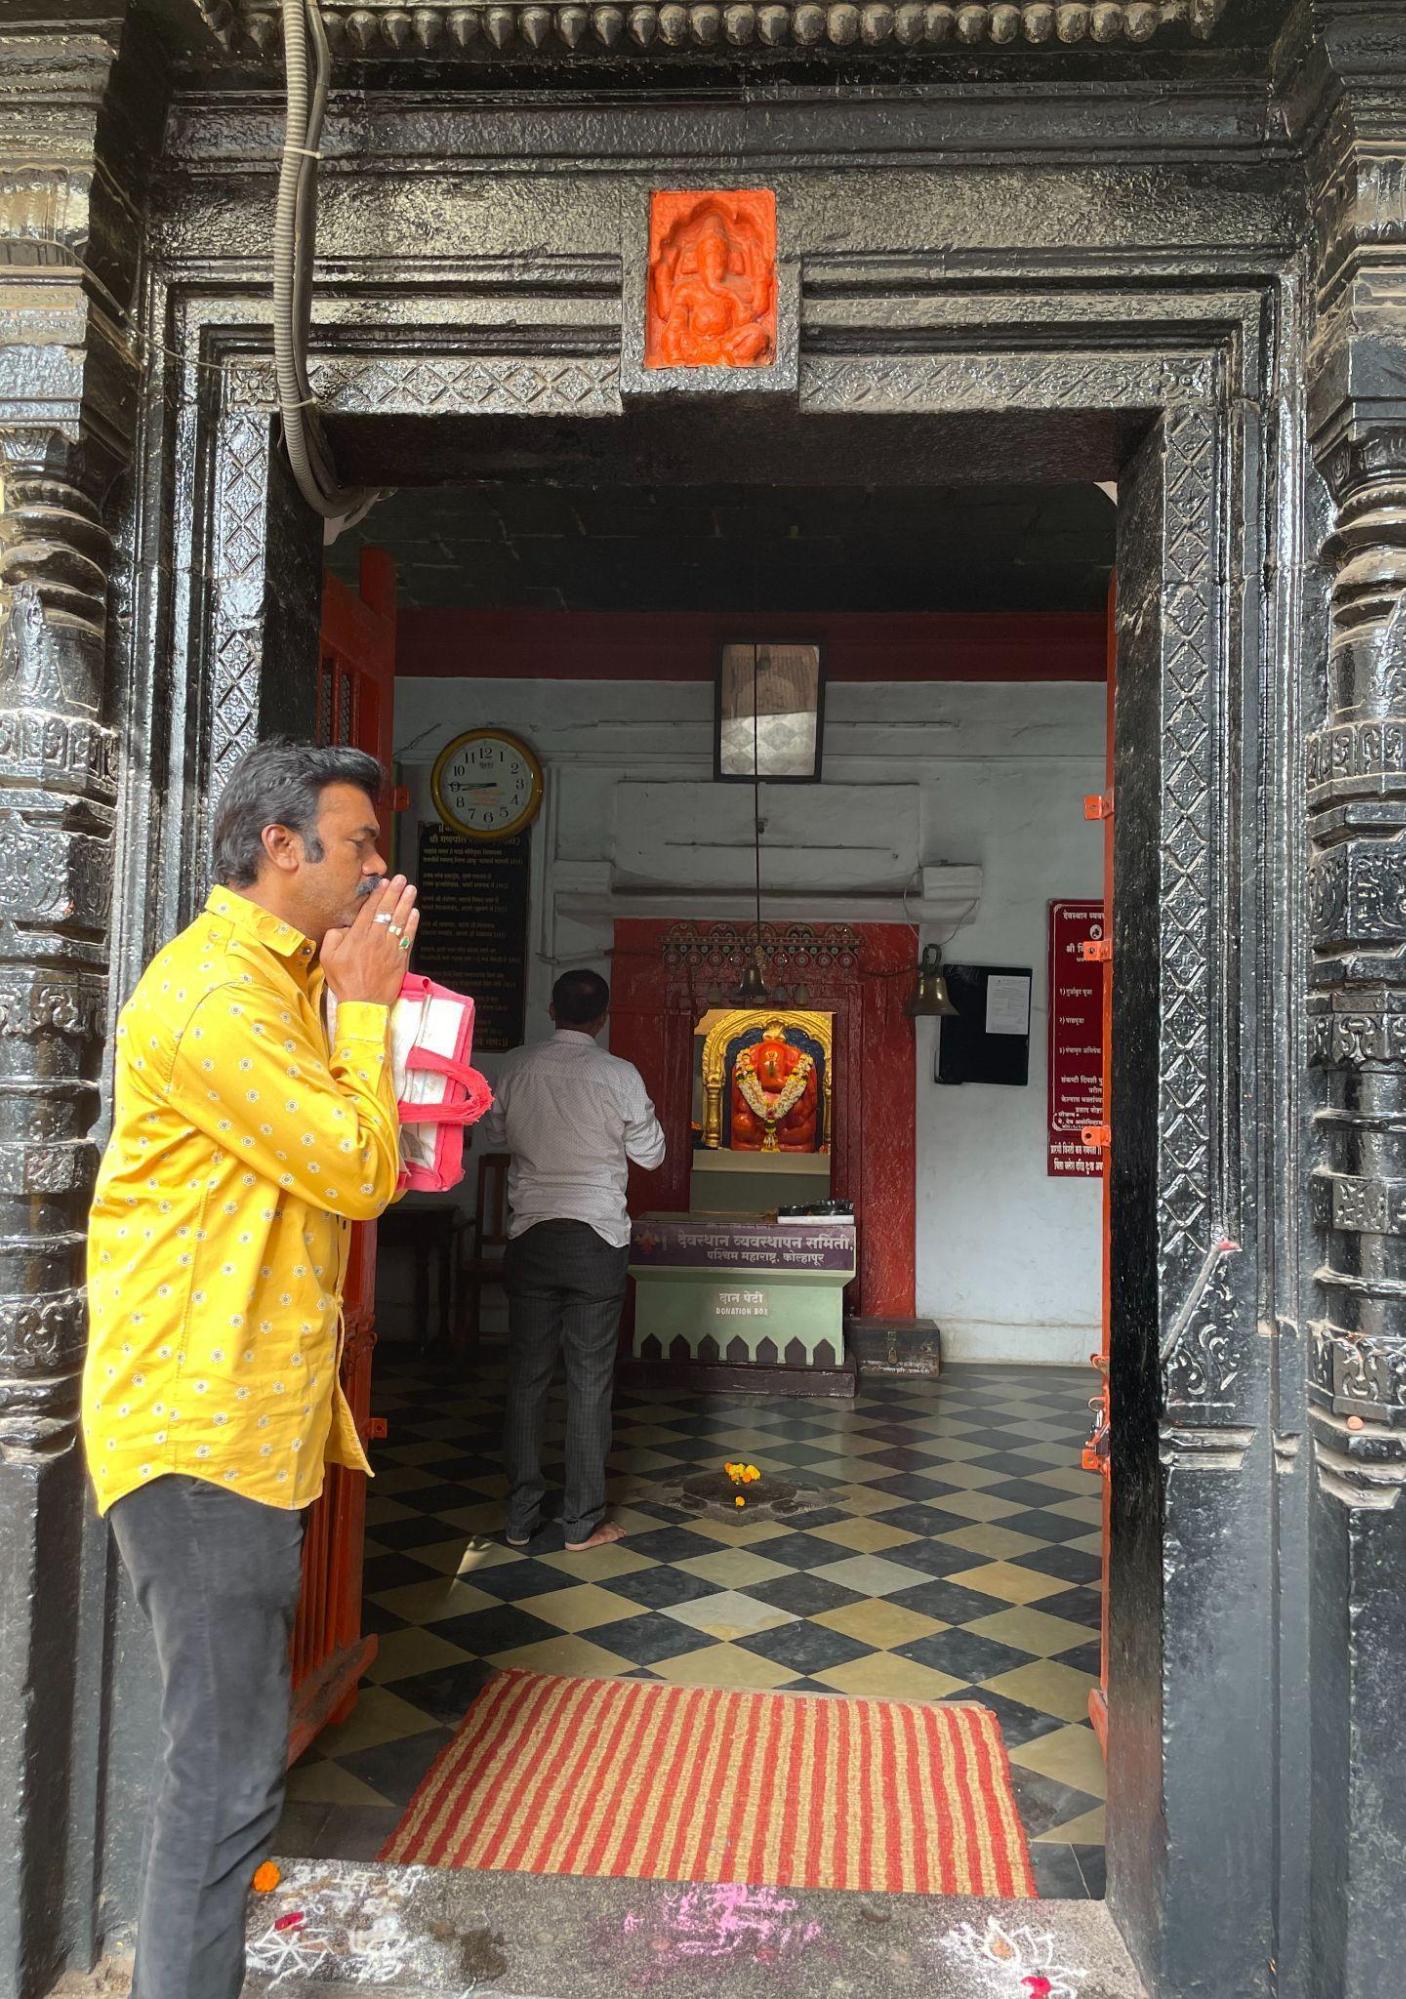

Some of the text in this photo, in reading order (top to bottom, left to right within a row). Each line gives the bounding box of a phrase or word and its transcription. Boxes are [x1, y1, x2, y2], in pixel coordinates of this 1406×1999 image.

[464, 752, 475, 764] 11
[479, 747, 493, 760] 12
[453, 765, 465, 777] 10
[511, 762, 519, 775] 2
[515, 779, 525, 790] 3
[456, 796, 465, 808] 8
[511, 794, 519, 806] 4
[467, 808, 476, 820] 7
[483, 812, 494, 824] 6
[500, 807, 509, 818] 5
[678, 1232, 729, 1249] देवस्थान
[734, 1234, 802, 1248] व्यवस्थापन
[707, 1248, 738, 1261] पश्चिम
[783, 1250, 824, 1266] कोल्हापूर
[719, 1290, 763, 1304] दान पेटी
[715, 1307, 768, 1316] DONATION BOX
